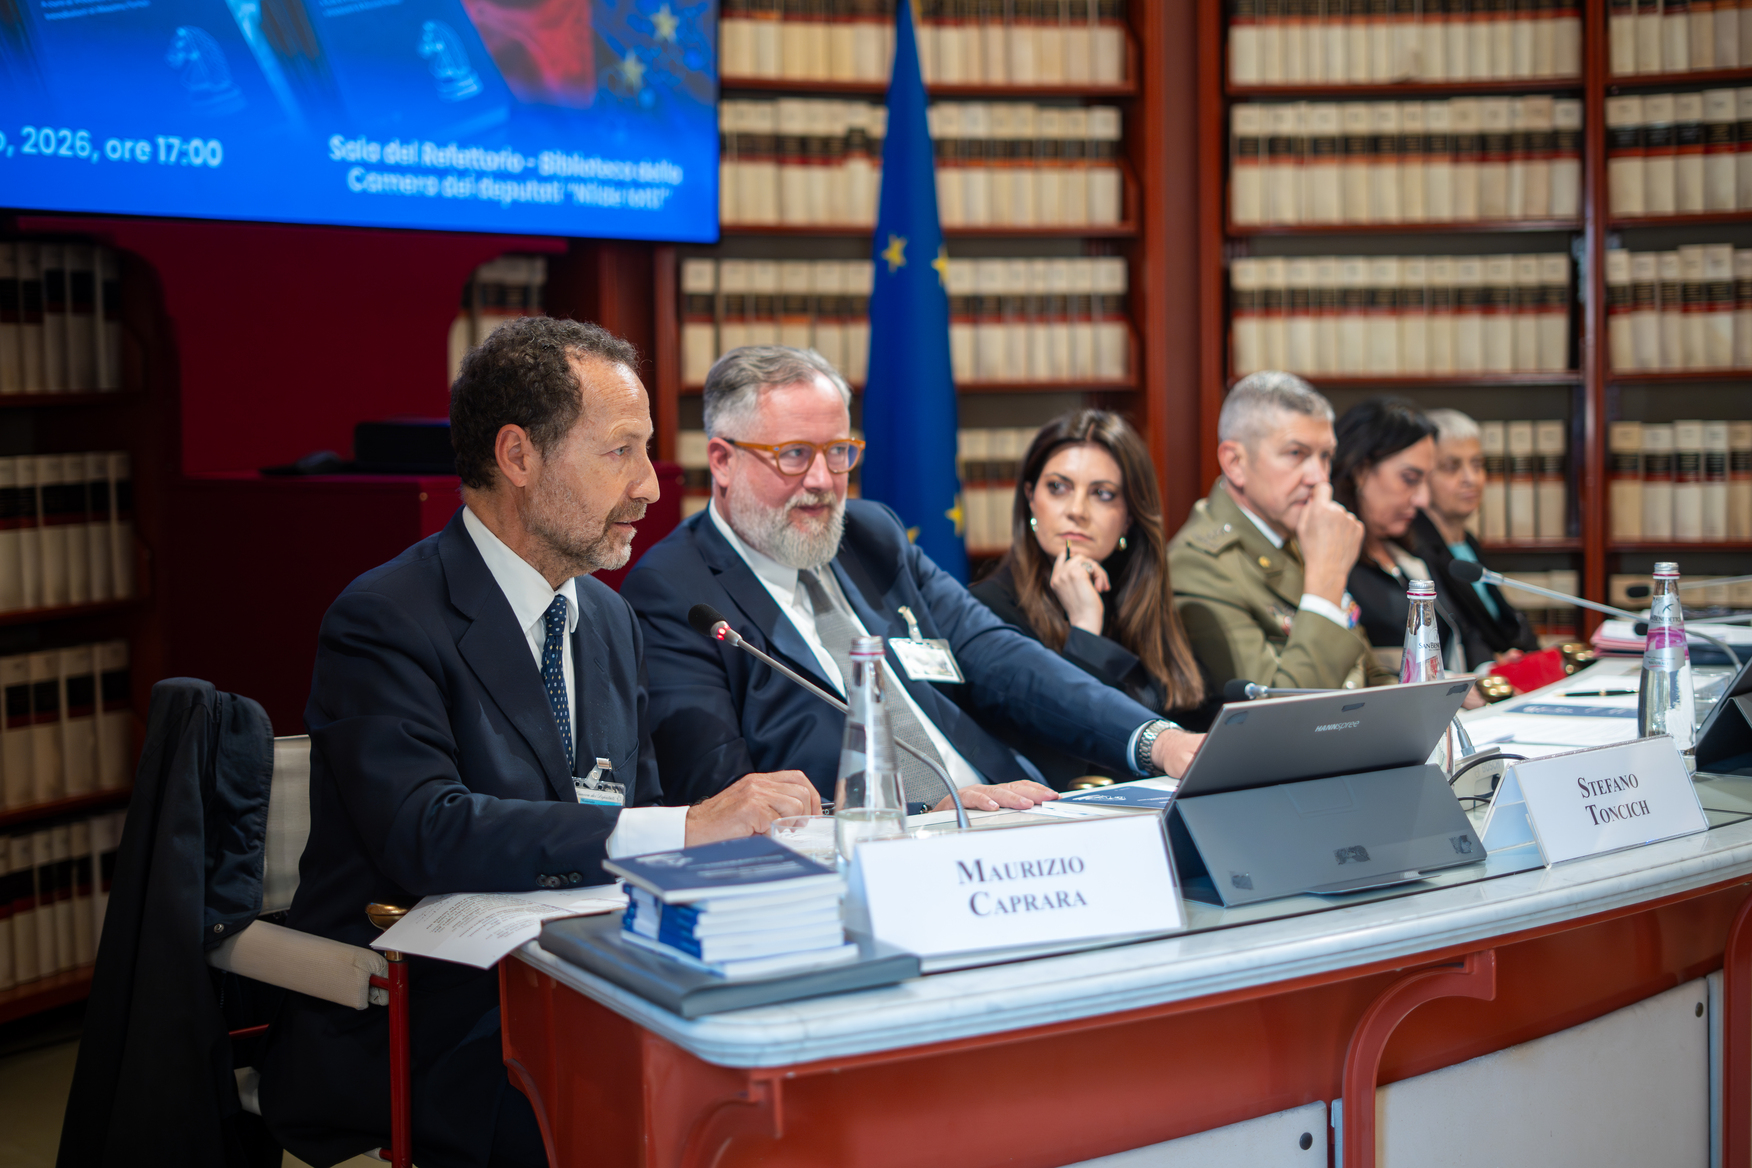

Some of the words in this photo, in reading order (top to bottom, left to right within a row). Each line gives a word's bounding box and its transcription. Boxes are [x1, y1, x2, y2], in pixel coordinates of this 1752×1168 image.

[20, 126, 99, 165] 2026,
[105, 137, 151, 164] ore
[156, 134, 223, 168] 17:00
[328, 134, 381, 163] Sala
[421, 141, 525, 175] Refettorio
[347, 166, 440, 196] Camera
[1577, 773, 1639, 799] STEFANO
[1584, 800, 1651, 826] TONCICH
[954, 855, 1086, 885] MAURIZIO
[968, 889, 1088, 917] CAPRARA
